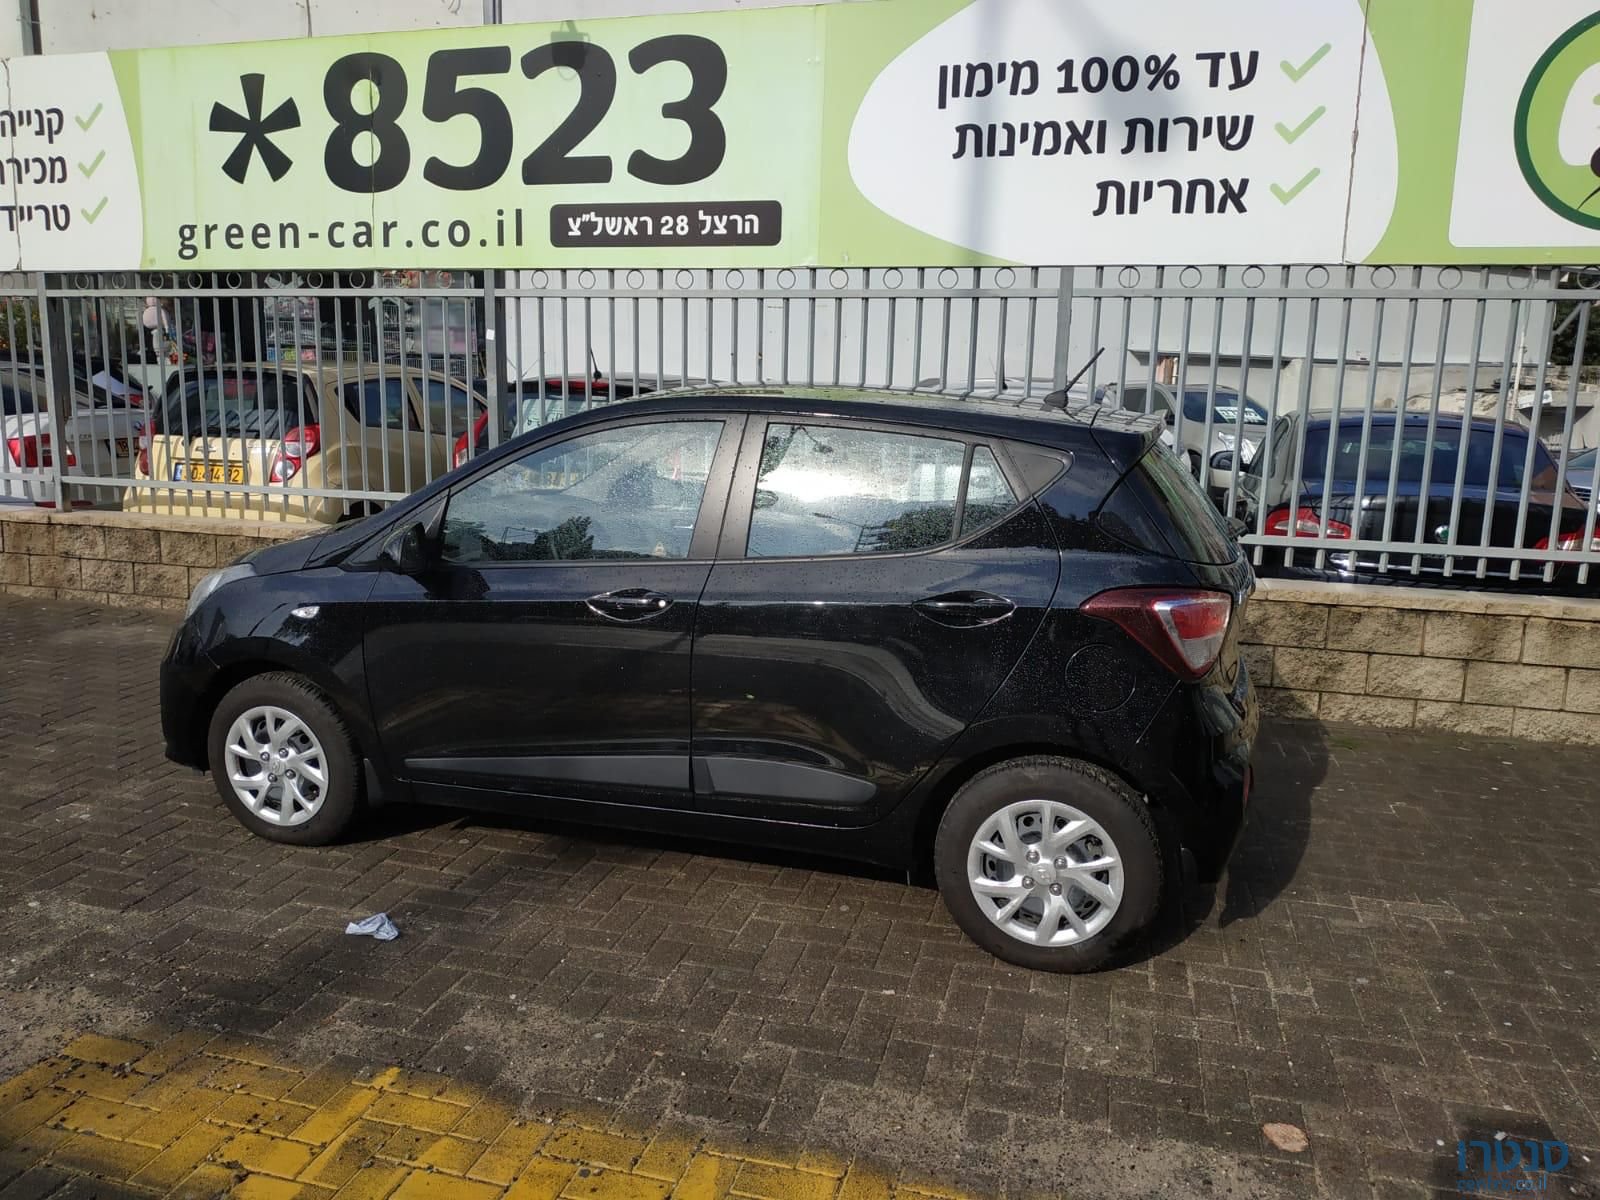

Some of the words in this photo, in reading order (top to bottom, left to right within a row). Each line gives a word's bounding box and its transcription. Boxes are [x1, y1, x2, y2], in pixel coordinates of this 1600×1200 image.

[938, 60, 1039, 110] מימון
[1056, 53, 1180, 94] 100%
[1195, 50, 1259, 91] עד
[0, 107, 65, 146] קנייה
[952, 119, 1107, 160] ואמינות
[1120, 114, 1254, 156] שירות
[0, 155, 68, 185] מכיר
[0, 203, 71, 232] טרייד
[1092, 178, 1250, 217] אחריות
[178, 208, 524, 261] green-car.co.il
[660, 214, 689, 236] 28
[698, 209, 760, 235] הרצל
